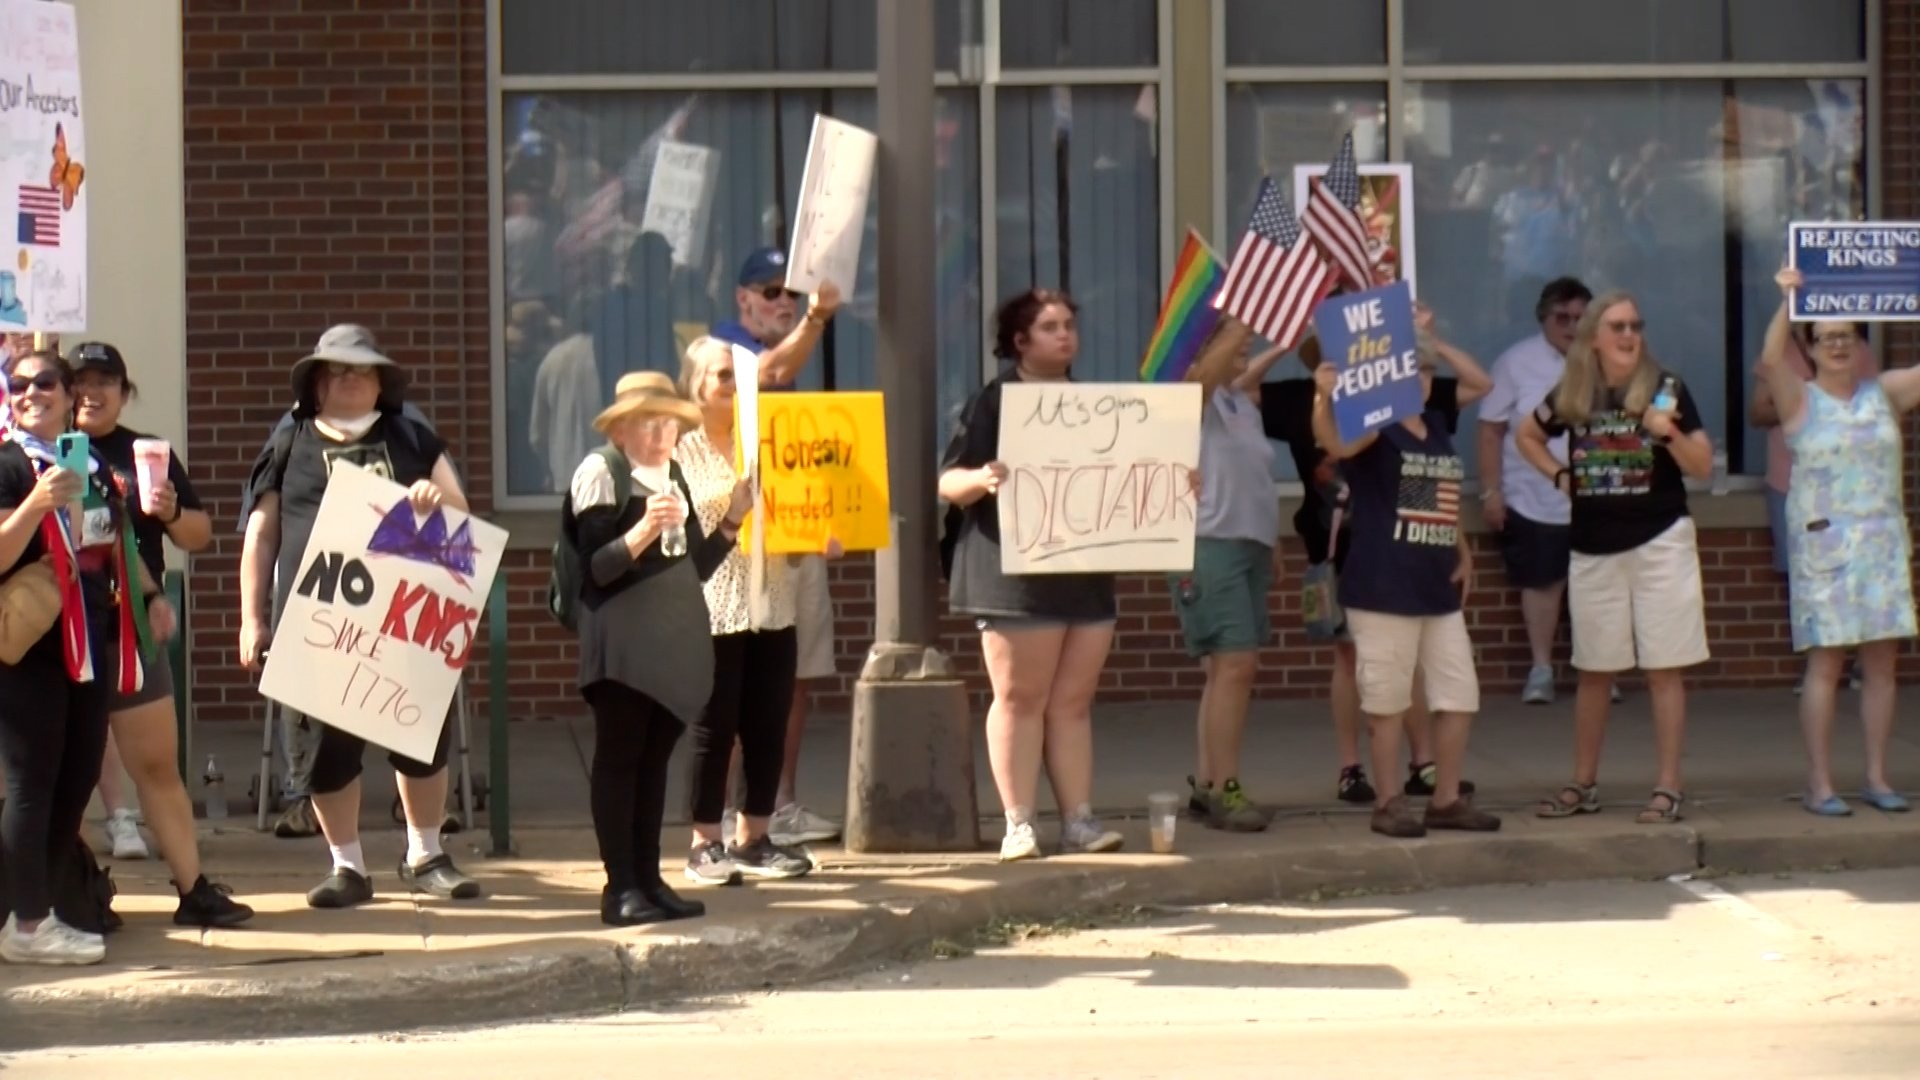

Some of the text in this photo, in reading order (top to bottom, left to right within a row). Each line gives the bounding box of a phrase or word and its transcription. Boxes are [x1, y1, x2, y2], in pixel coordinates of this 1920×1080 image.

[1800, 230, 1920, 248] REJECTING
[1826, 248, 1897, 266] KINGS
[1343, 299, 1384, 333] WE
[1804, 293, 1919, 312] SINCE 1776
[1346, 334, 1392, 364] the
[1331, 349, 1417, 402] PEOPLE
[760, 415, 853, 470] Honesty
[763, 486, 834, 525] Needed
[1013, 461, 1194, 554] DICTATOR
[297, 549, 375, 608] NO
[303, 608, 382, 661] SINCE
[341, 661, 422, 726] 1776
